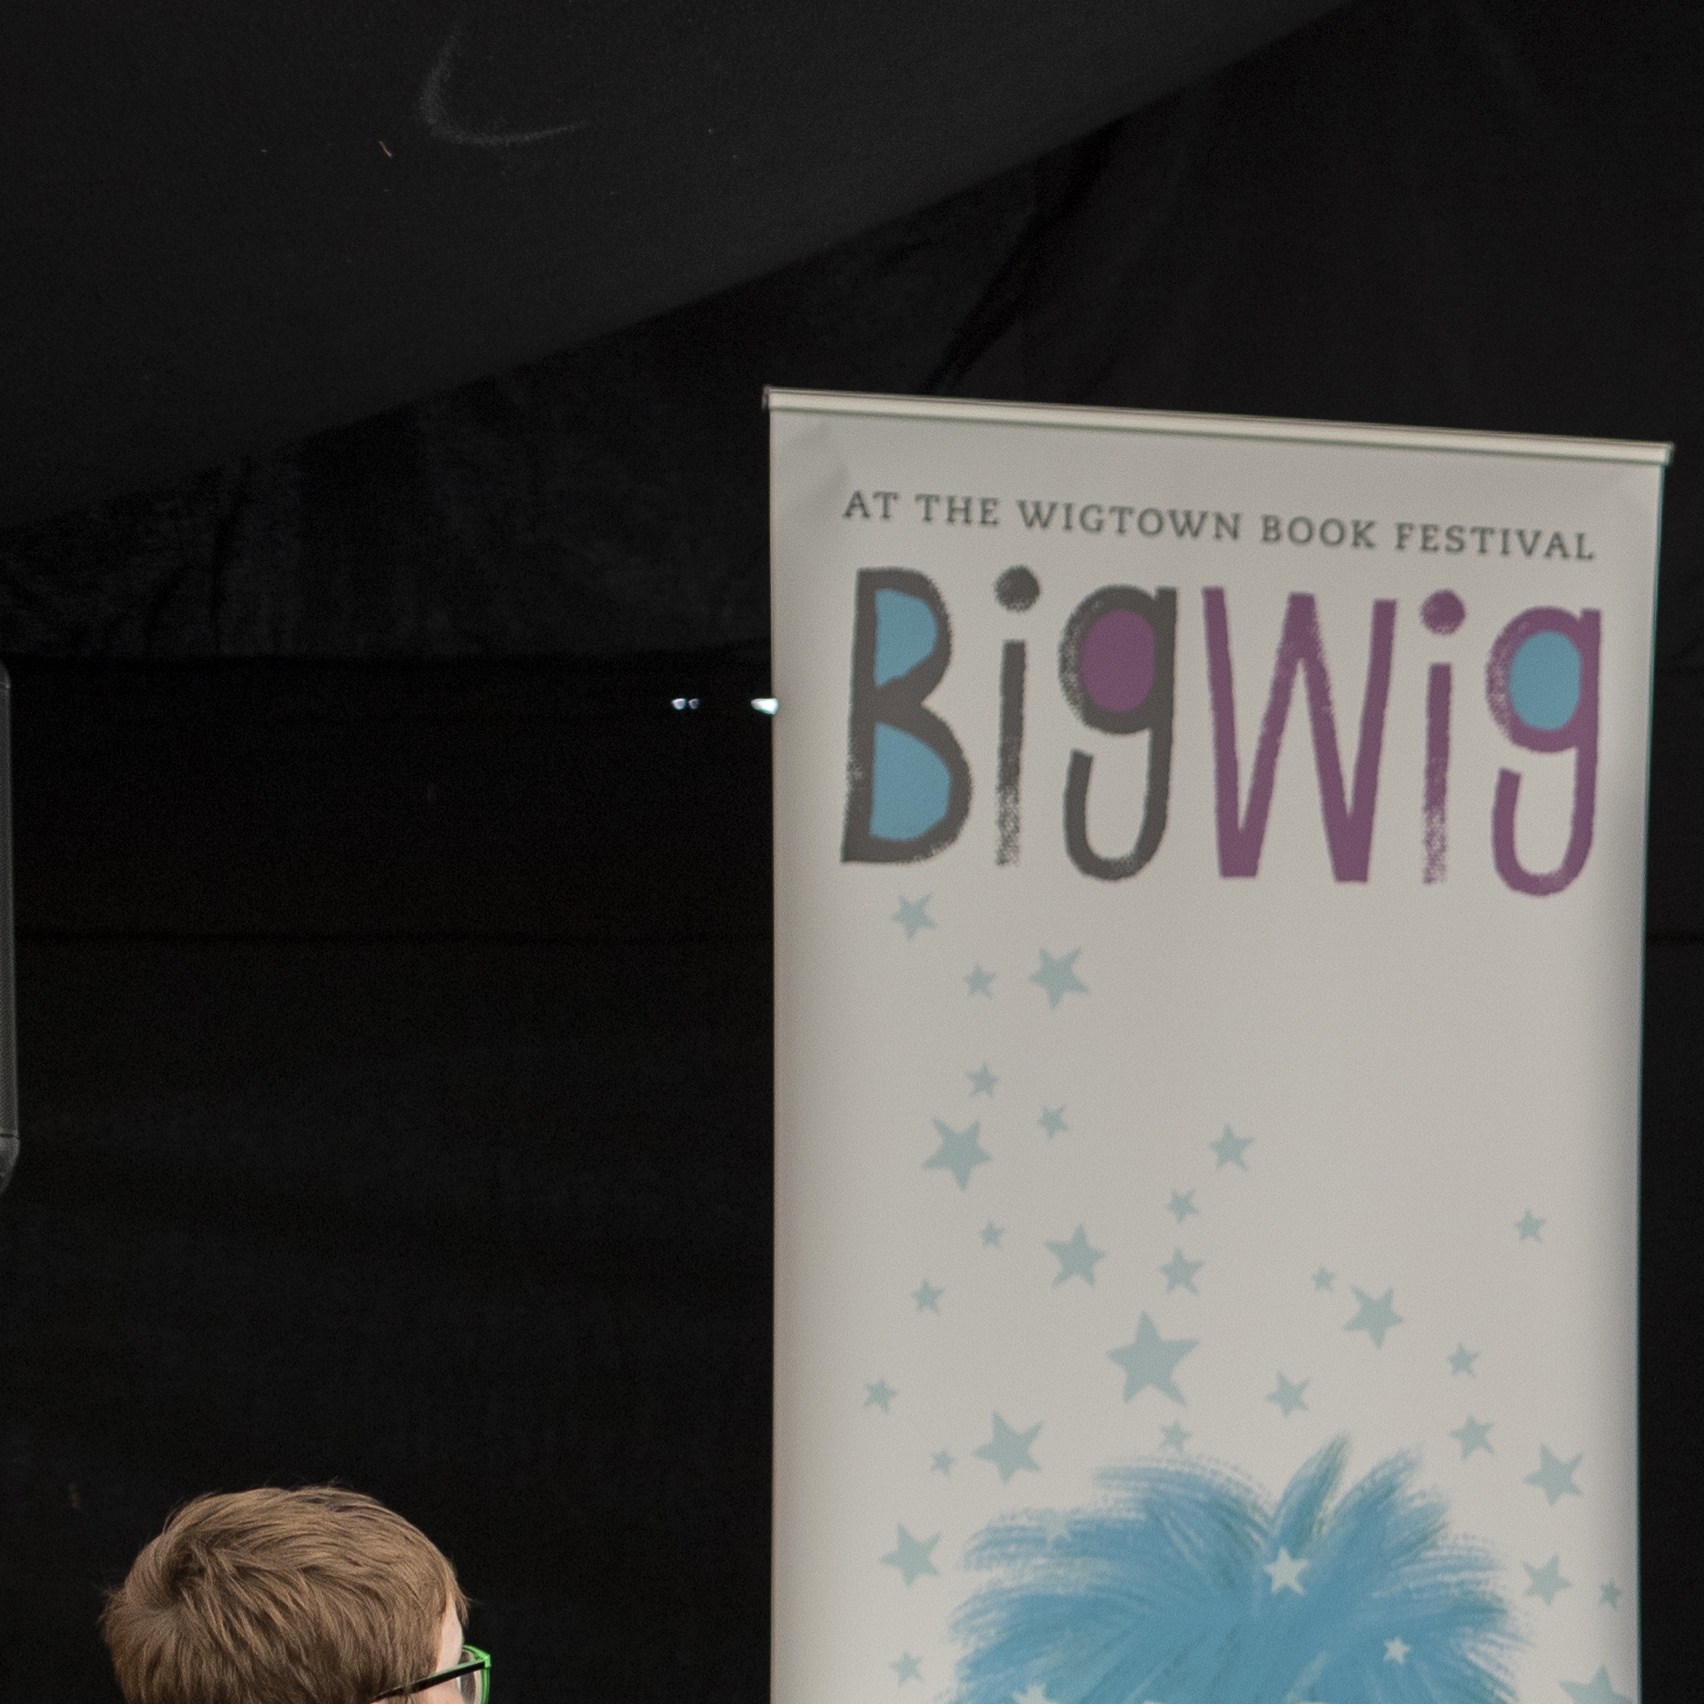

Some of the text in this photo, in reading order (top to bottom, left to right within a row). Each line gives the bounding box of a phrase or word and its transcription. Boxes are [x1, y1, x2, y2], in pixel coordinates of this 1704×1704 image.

[843, 491, 1596, 561] AT THE WIGTOWN BOOK FESTIVAL
